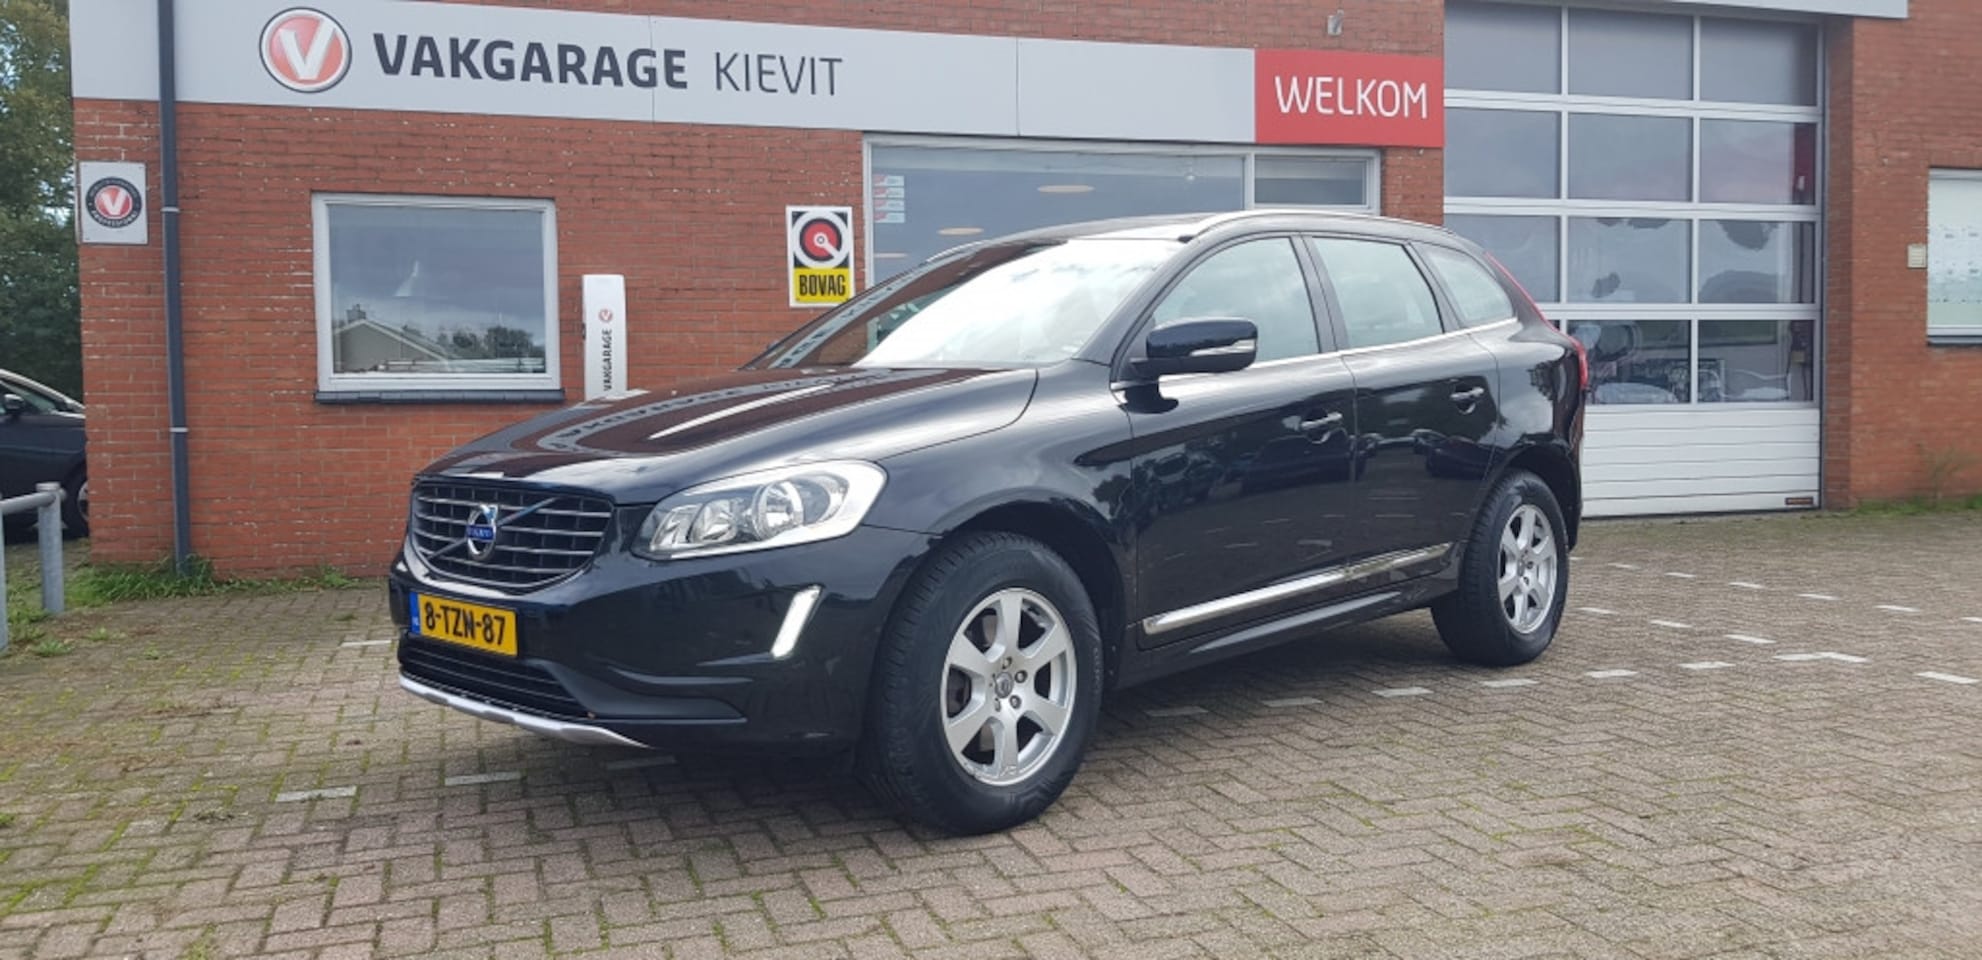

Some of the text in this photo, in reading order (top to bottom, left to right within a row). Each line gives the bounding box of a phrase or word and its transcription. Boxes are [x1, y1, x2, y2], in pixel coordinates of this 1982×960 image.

[278, 18, 337, 81] V
[373, 32, 843, 96] VAKGARAGE KIEVIT
[1275, 75, 1427, 119] WELKOM
[799, 273, 846, 297] BOVAG
[601, 328, 612, 392] VAKGARAGE
[424, 601, 506, 646] 8-TZN-87
